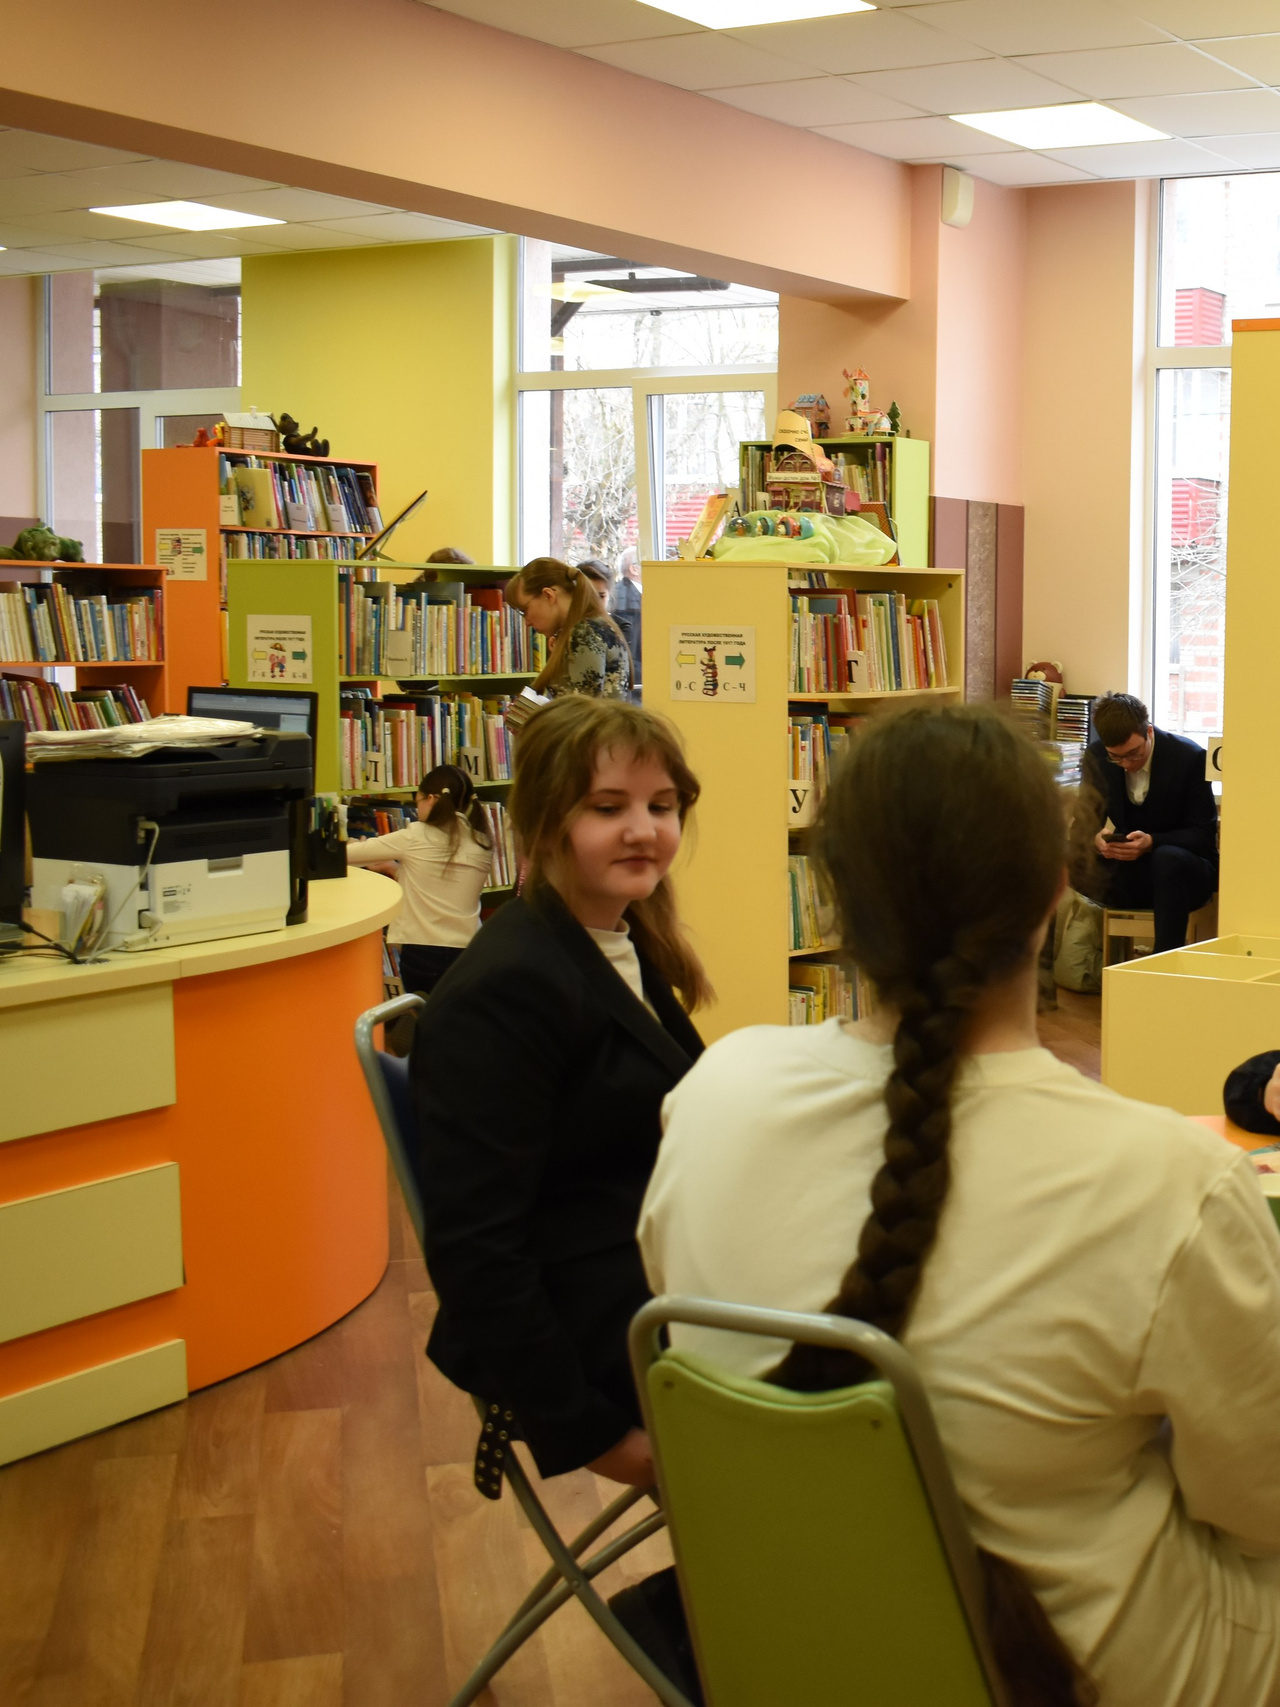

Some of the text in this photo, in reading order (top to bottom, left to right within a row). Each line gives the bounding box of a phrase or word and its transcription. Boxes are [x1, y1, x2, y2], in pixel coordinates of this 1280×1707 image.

[366, 760, 380, 782] Л
[464, 754, 479, 776] М
[790, 788, 809, 814] У
